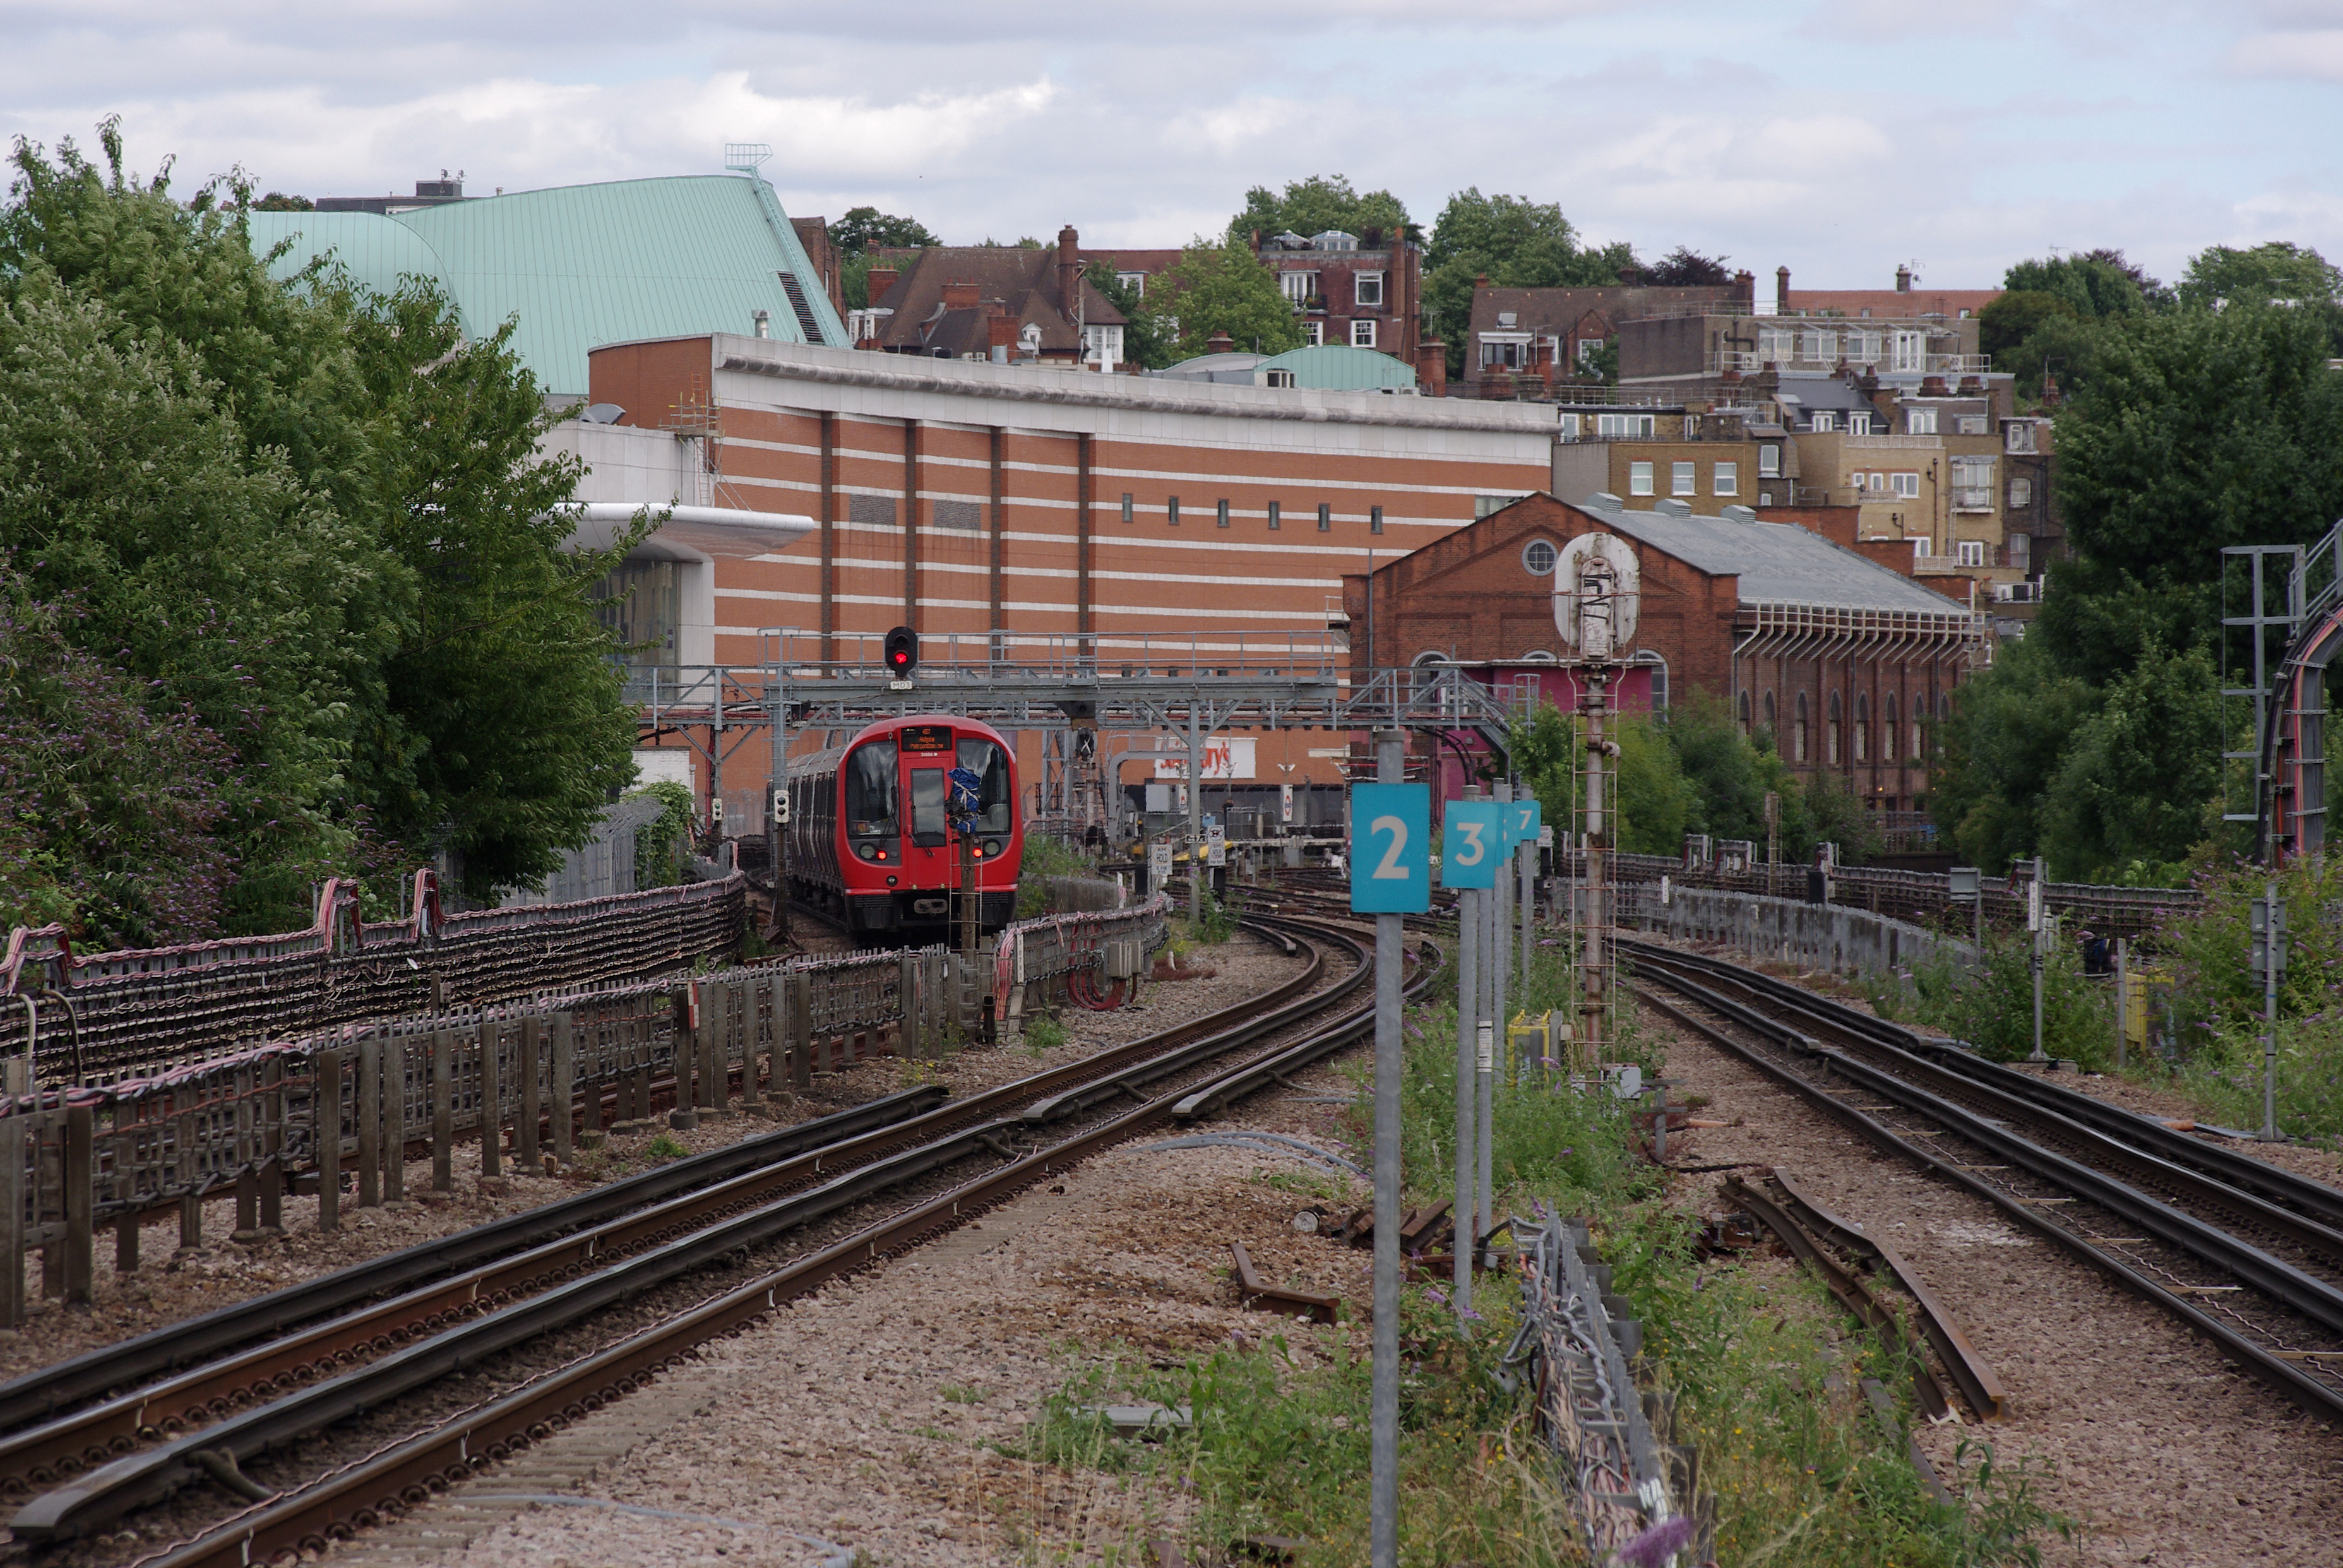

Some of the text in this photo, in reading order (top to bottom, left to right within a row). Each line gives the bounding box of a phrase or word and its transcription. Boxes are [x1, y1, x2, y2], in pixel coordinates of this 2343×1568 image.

[1160, 740, 1231, 775] Saiury's
[1520, 811, 1533, 830] 7
[1156, 853, 1168, 863] HOLD
[1371, 815, 1409, 879] 2
[1455, 823, 1484, 866] 3
